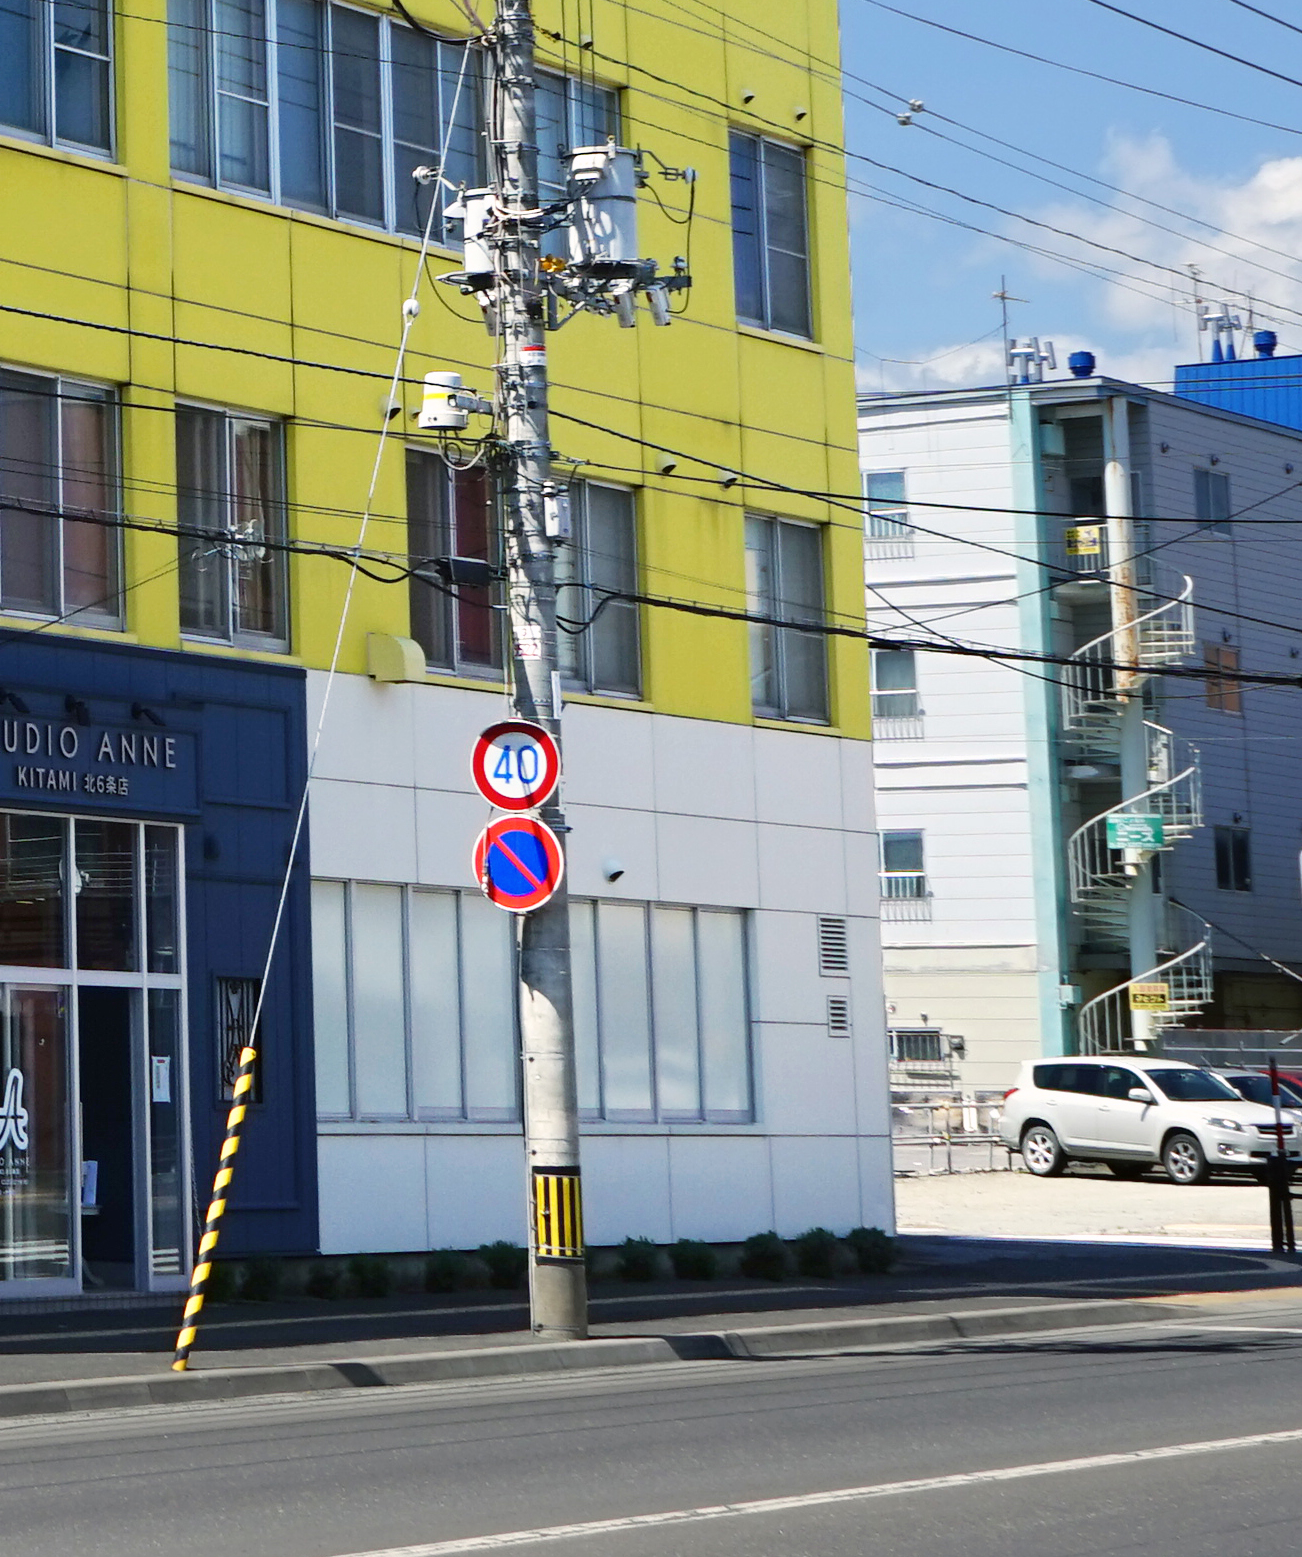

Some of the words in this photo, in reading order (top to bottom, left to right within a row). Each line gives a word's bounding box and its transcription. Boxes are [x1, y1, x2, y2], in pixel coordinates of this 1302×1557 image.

[98, 731, 177, 769] ANNE
[493, 745, 538, 784] 40
[18, 765, 77, 792] KITAMI
[84, 774, 129, 796] 北6条店
